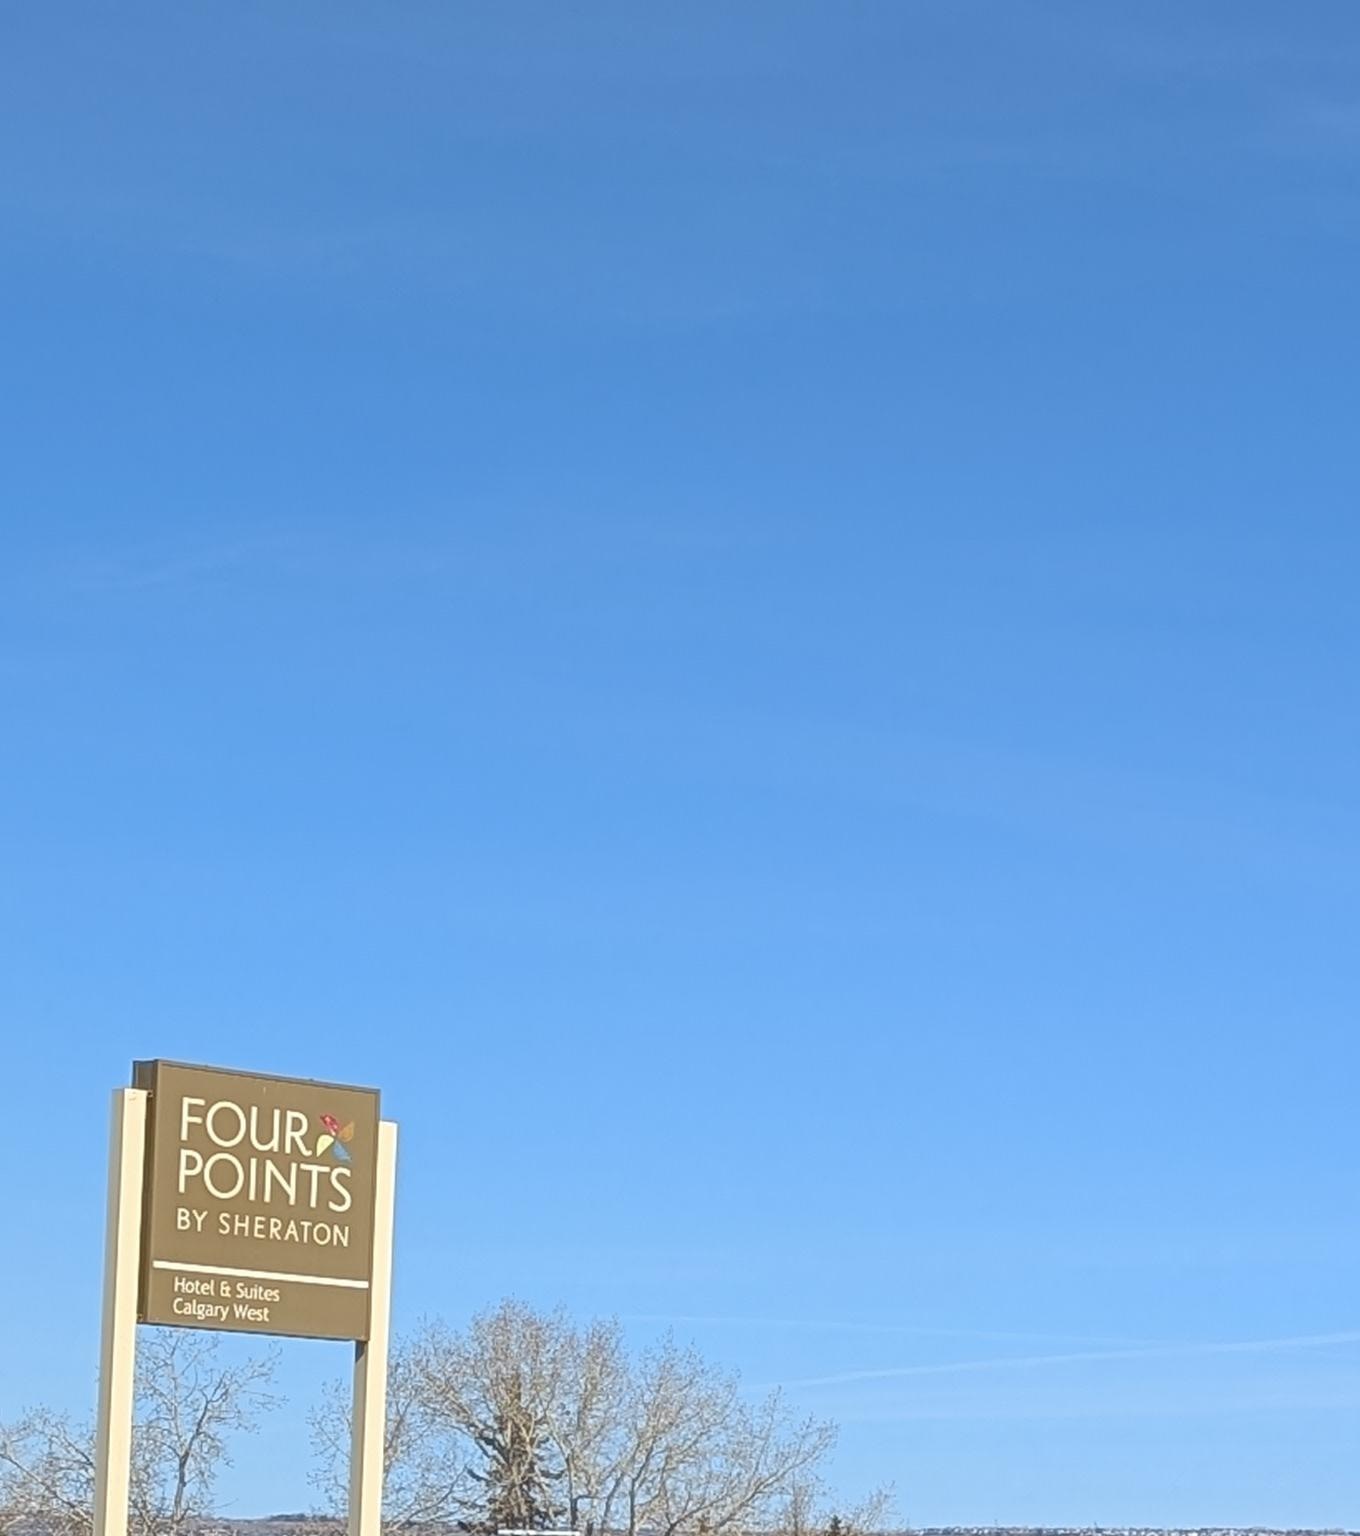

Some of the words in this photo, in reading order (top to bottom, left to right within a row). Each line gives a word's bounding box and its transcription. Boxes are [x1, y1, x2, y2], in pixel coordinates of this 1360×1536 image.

[180, 1096, 313, 1158] FOUR
[178, 1148, 352, 1214] POINTS
[176, 1207, 209, 1233] BY
[218, 1212, 350, 1248] SHERATON
[172, 1297, 229, 1321] Calgary
[233, 1302, 270, 1322] West
[174, 1276, 215, 1297] Hotel
[220, 1282, 232, 1298] &
[235, 1282, 281, 1303] Suites
